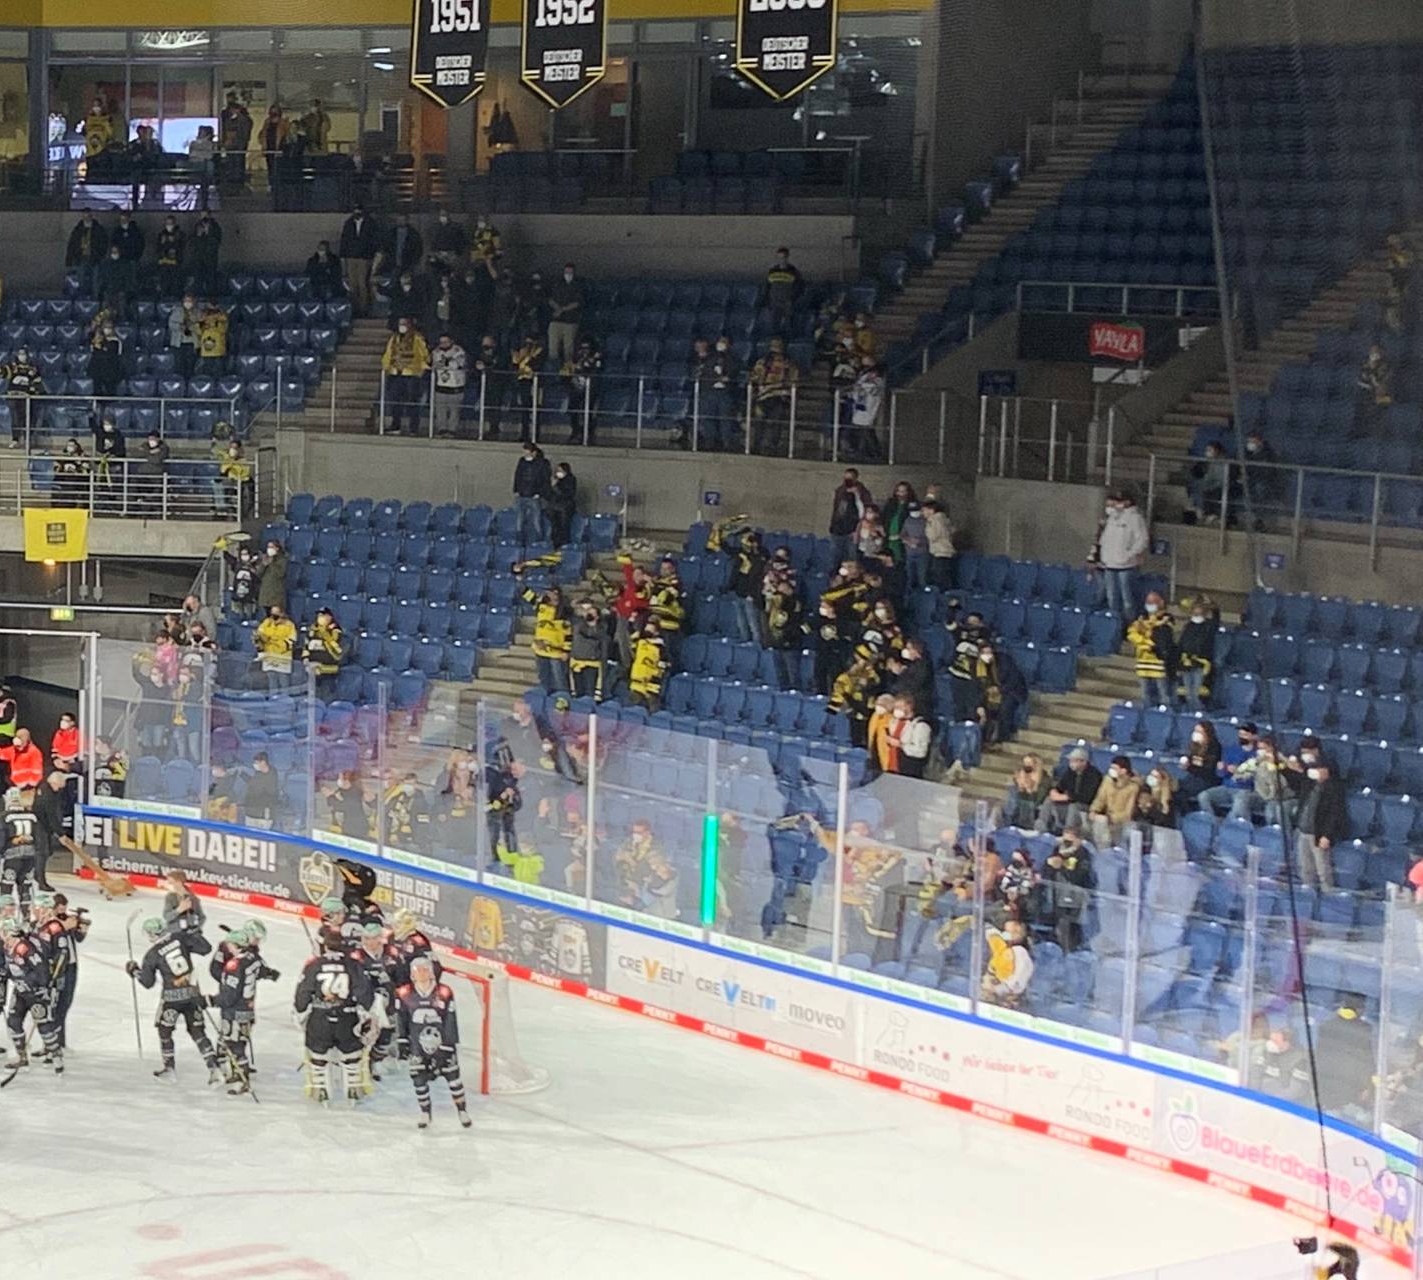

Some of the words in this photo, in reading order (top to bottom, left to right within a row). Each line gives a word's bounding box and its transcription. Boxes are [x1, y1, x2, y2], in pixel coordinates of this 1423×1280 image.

[430, 0, 481, 33] 1951
[543, 64, 580, 81] MEISTER
[763, 52, 806, 70] MEISTER
[436, 70, 470, 86] MEISTER
[119, 820, 182, 856] LIVE
[187, 829, 277, 873] DABEI!
[102, 856, 160, 877] sichern:
[161, 864, 291, 899] ww.kev-tickets.de
[393, 891, 436, 918] STOFF!
[165, 947, 190, 977] 6
[618, 954, 685, 985] CREVELT
[316, 972, 350, 1000] 74
[789, 1002, 846, 1031] moveo
[873, 1049, 916, 1074] RONDO
[917, 1061, 951, 1083] FOOD
[1065, 1104, 1112, 1130] RONDO
[1200, 1125, 1384, 1213] BlaueErdbeere.de
